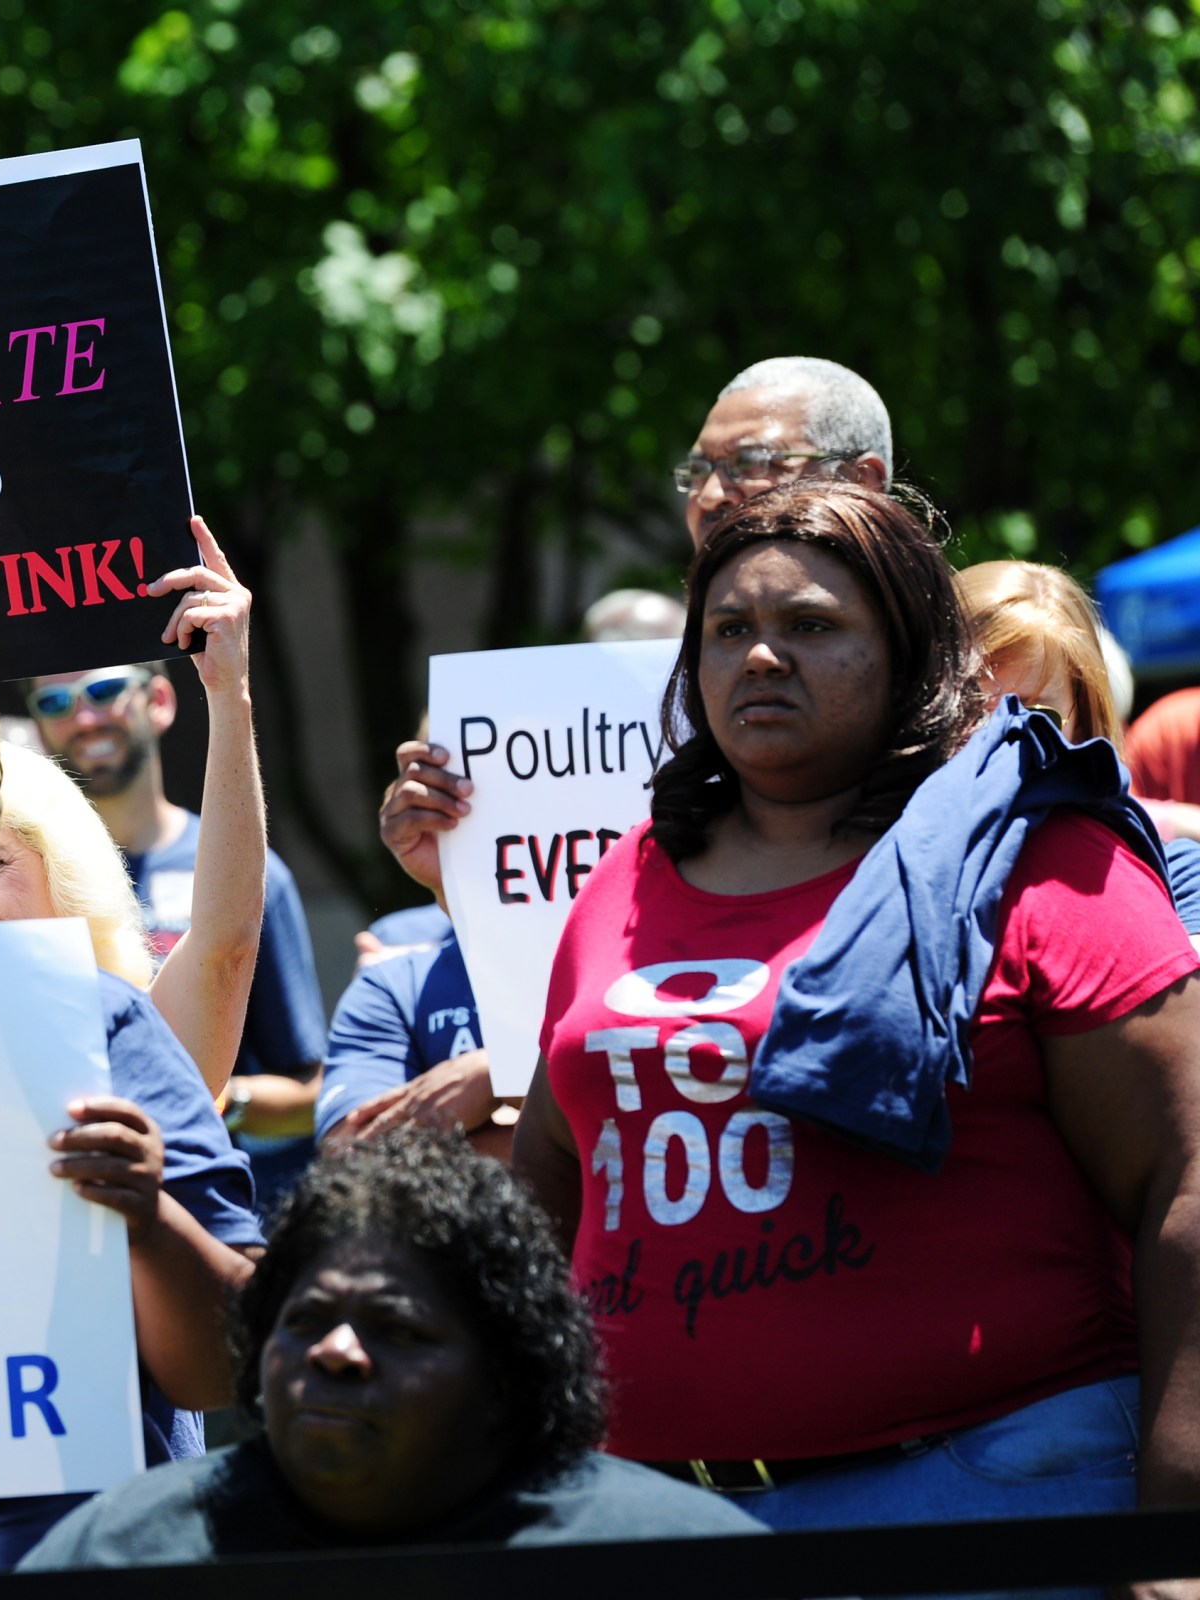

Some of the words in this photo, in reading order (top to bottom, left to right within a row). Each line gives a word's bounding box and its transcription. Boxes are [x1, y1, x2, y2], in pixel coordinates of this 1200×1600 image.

[460, 707, 664, 790] Poultry
[584, 1021, 749, 1112] TO
[591, 1109, 794, 1231] 100
[673, 1193, 875, 1338] quick
